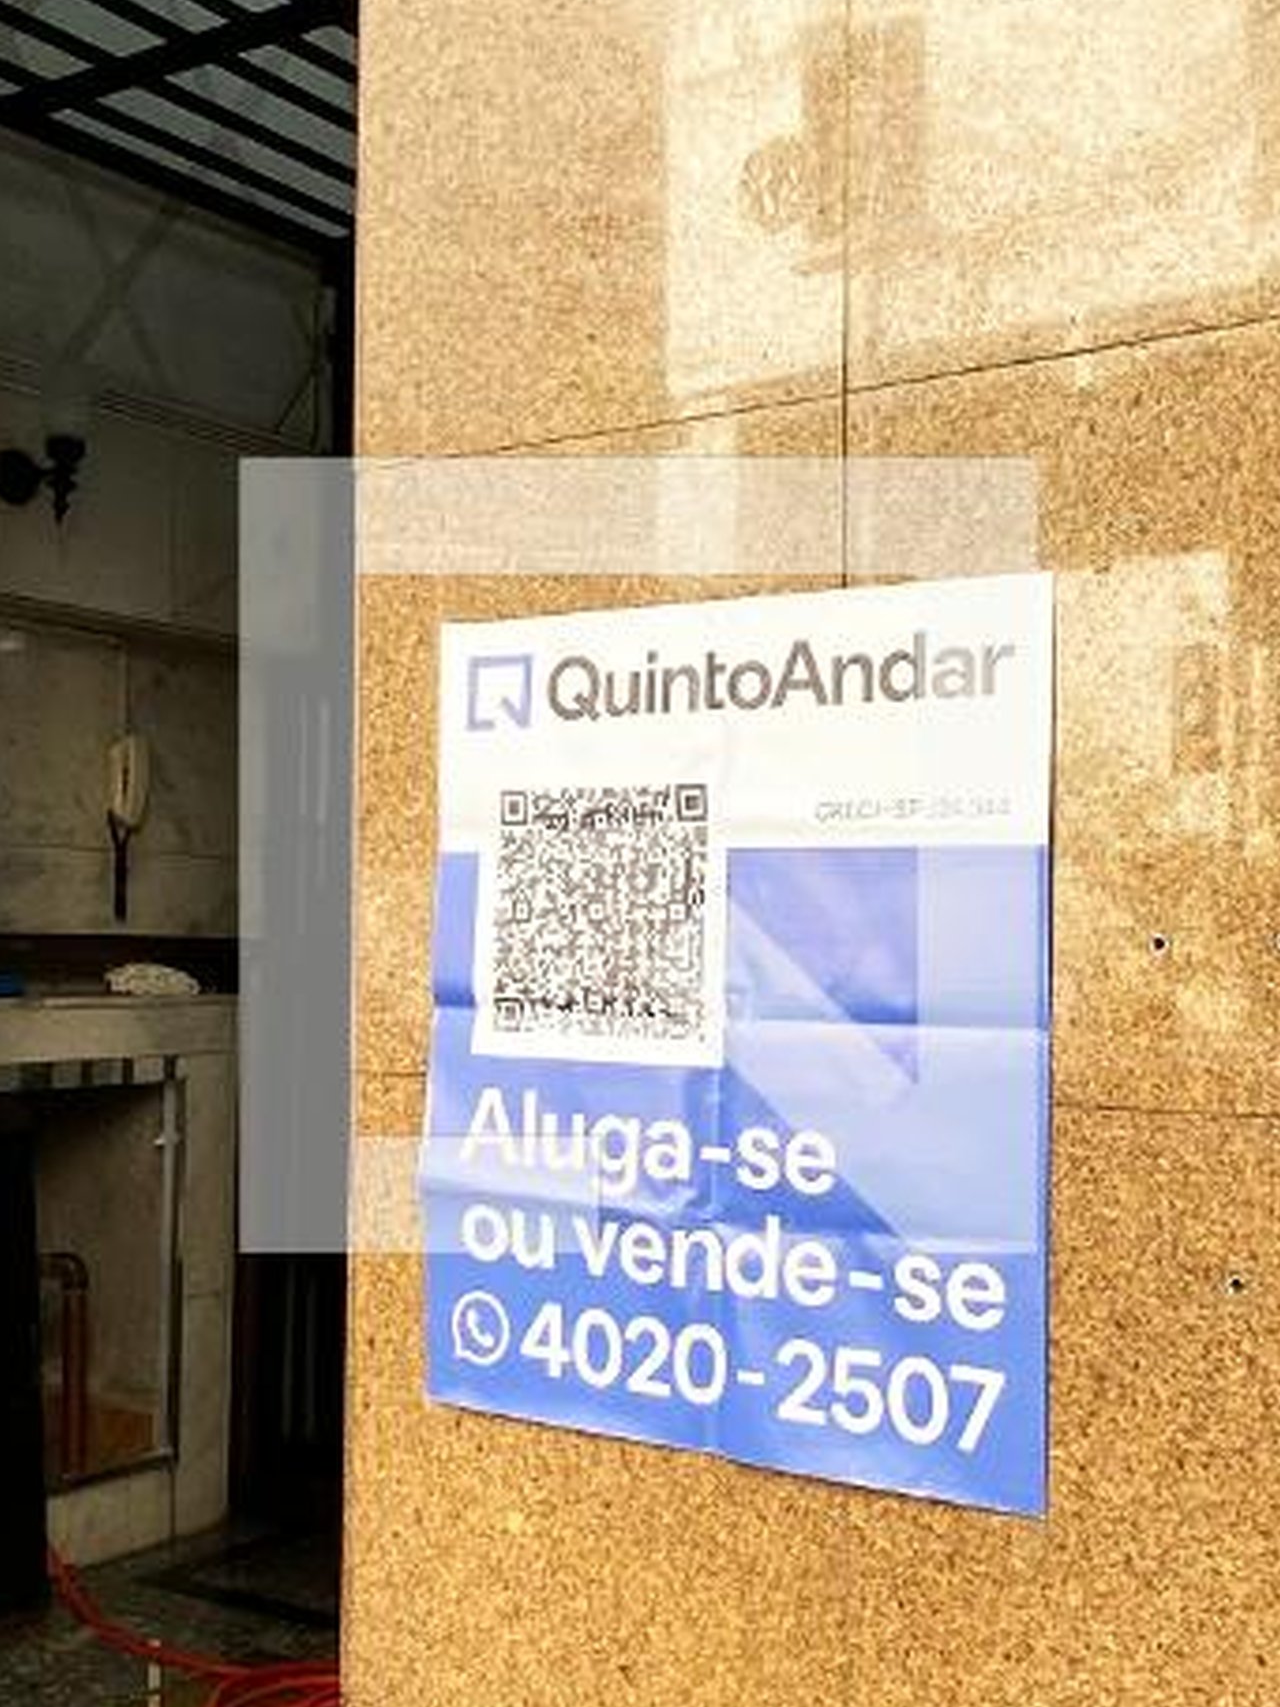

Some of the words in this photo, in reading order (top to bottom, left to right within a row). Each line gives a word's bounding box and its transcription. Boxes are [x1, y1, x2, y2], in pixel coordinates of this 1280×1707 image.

[546, 631, 1016, 722] QuintoAndar
[460, 1087, 838, 1195] Aluga-se
[460, 1202, 556, 1271] ou
[572, 1215, 1007, 1331] vende-se
[519, 1302, 1006, 1455] 4020-2507
